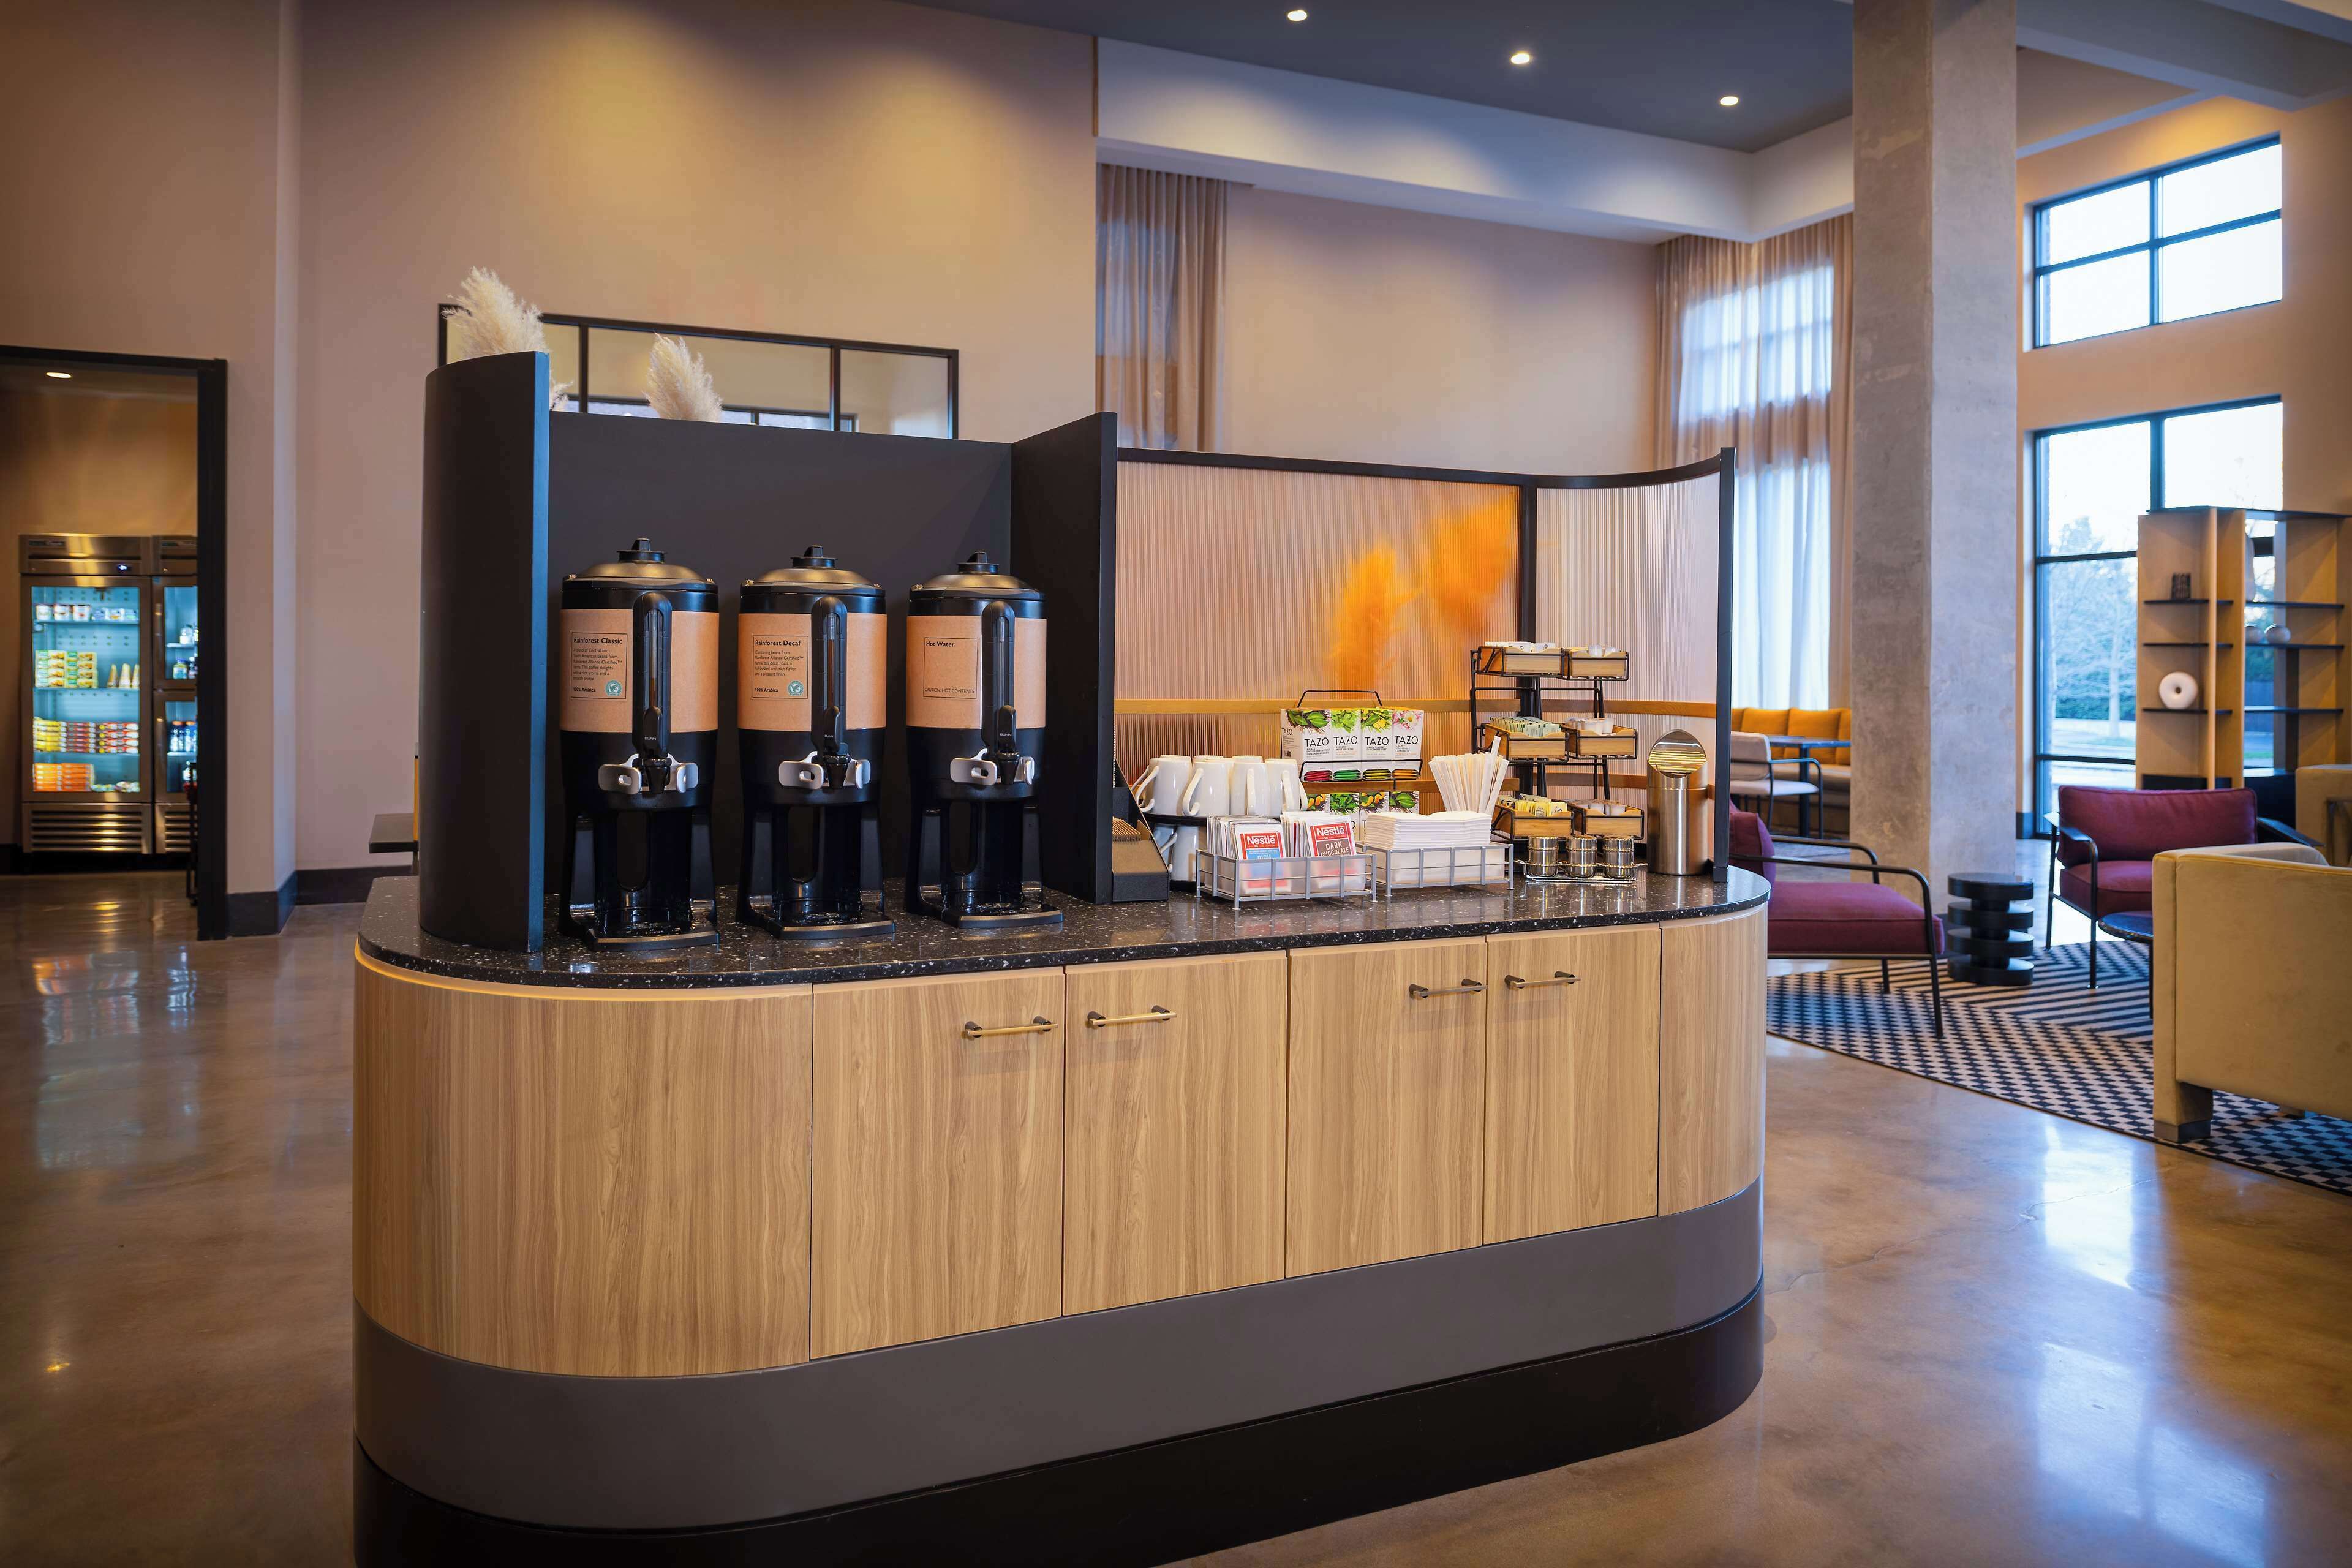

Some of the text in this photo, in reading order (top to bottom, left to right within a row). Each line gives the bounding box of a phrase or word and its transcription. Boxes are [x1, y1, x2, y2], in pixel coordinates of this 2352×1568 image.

[1304, 737, 1329, 747] TAZO
[1333, 736, 1358, 745] TAZO
[1365, 737, 1389, 745] TAZO
[1394, 735, 1419, 745] TAZO
[1317, 826, 1345, 837] Nestlé
[1246, 835, 1276, 845] Nestlé
[1325, 841, 1343, 850] DARK
[1321, 846, 1349, 858] CHOCOLATE
